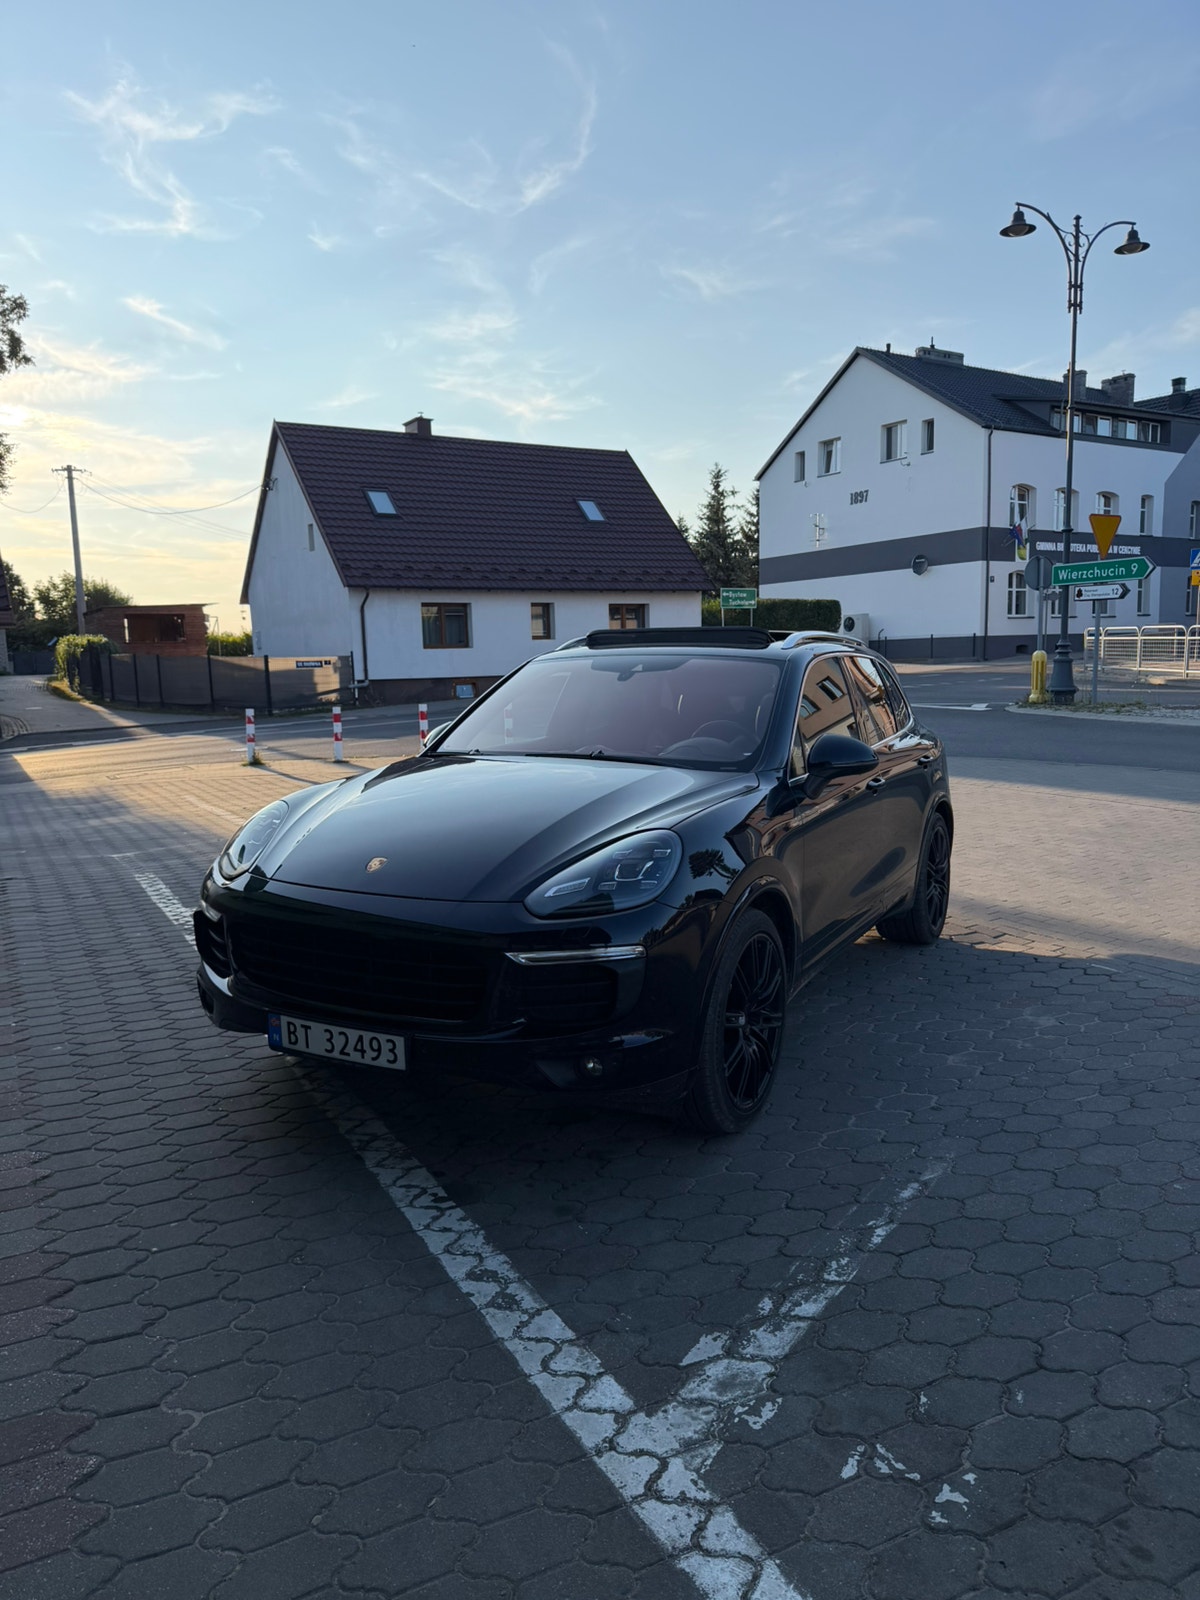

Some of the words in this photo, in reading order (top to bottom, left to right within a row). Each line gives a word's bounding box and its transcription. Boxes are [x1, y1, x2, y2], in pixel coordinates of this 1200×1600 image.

[850, 489, 869, 505] 1897
[1035, 541, 1056, 551] GMINNA
[1086, 544, 1113, 554] PUBLA
[1058, 565, 1126, 580] Wierzchucin
[1131, 563, 1138, 575] 9
[1111, 588, 1119, 596] 12
[286, 1021, 312, 1049] BT
[323, 1028, 399, 1064] 32493
